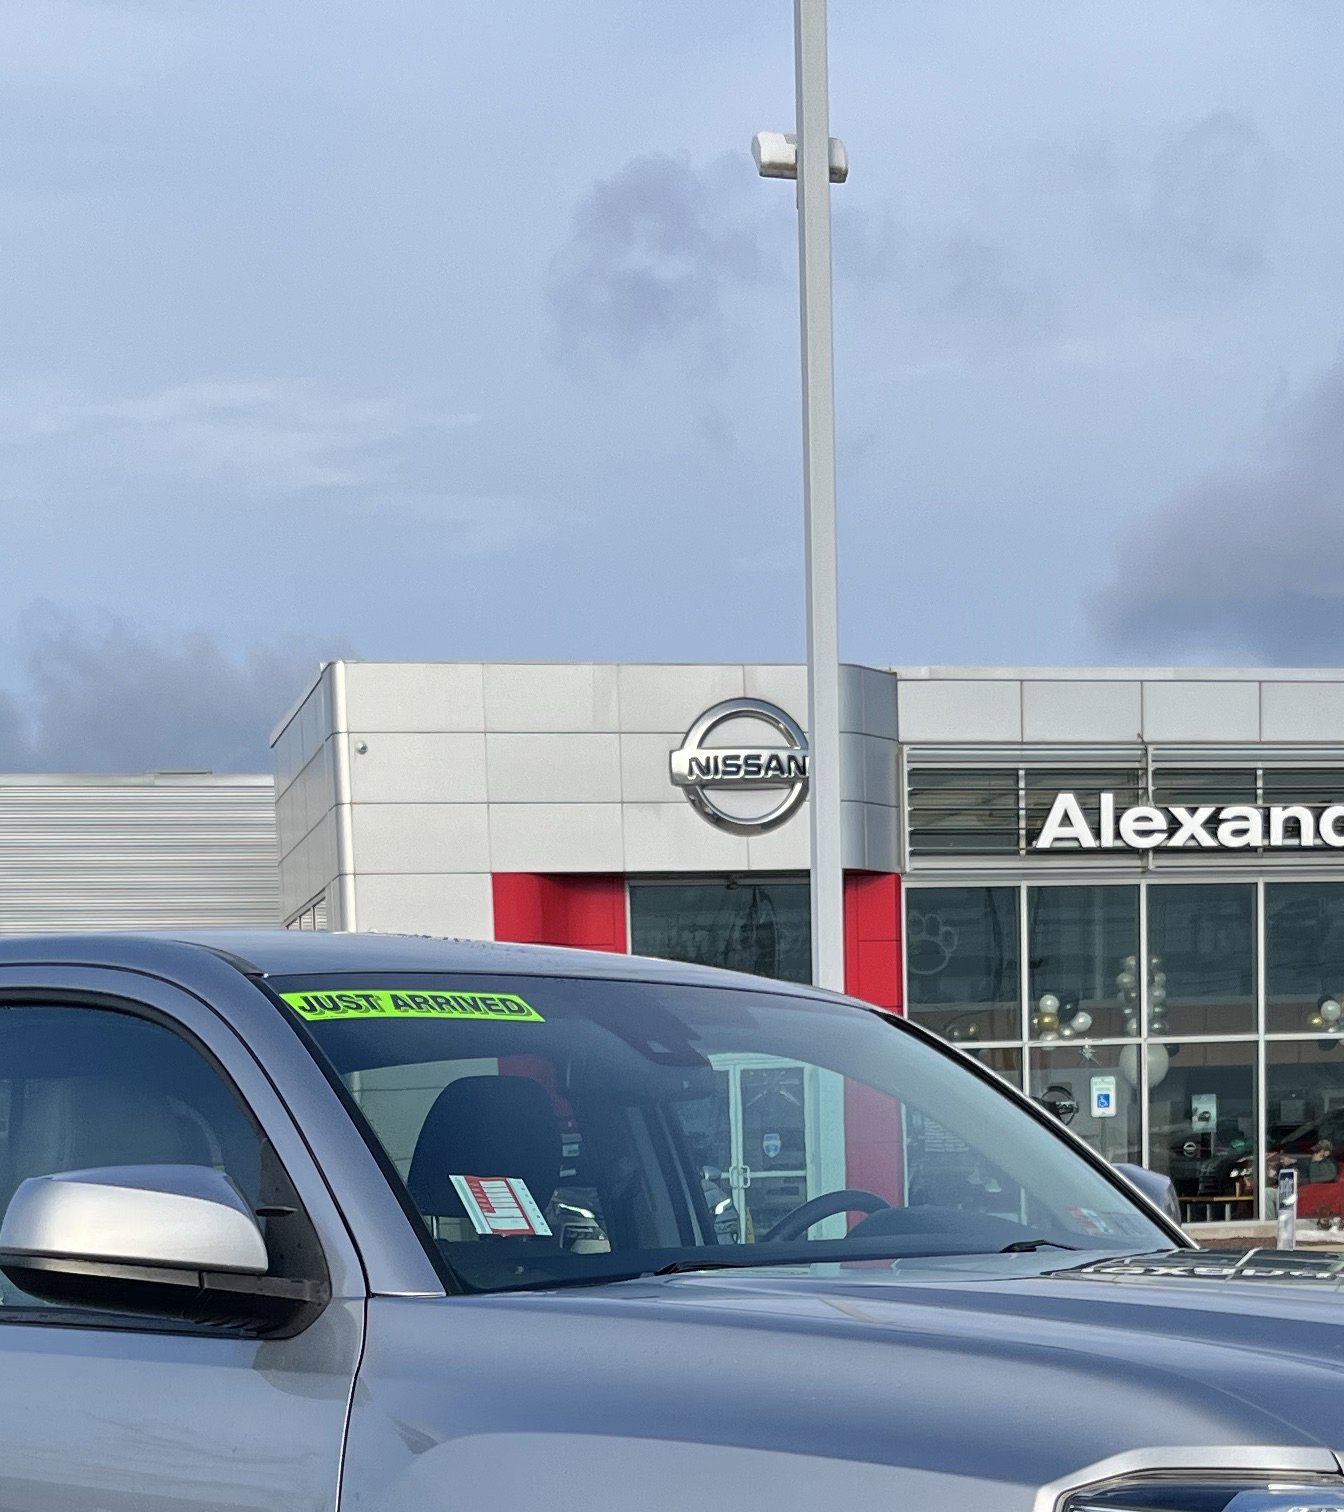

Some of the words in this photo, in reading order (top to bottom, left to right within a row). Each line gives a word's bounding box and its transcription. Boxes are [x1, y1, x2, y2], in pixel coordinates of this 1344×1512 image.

[688, 754, 809, 779] NISSAN
[297, 992, 383, 1016] JUST
[389, 993, 534, 1017] ARRIVED
